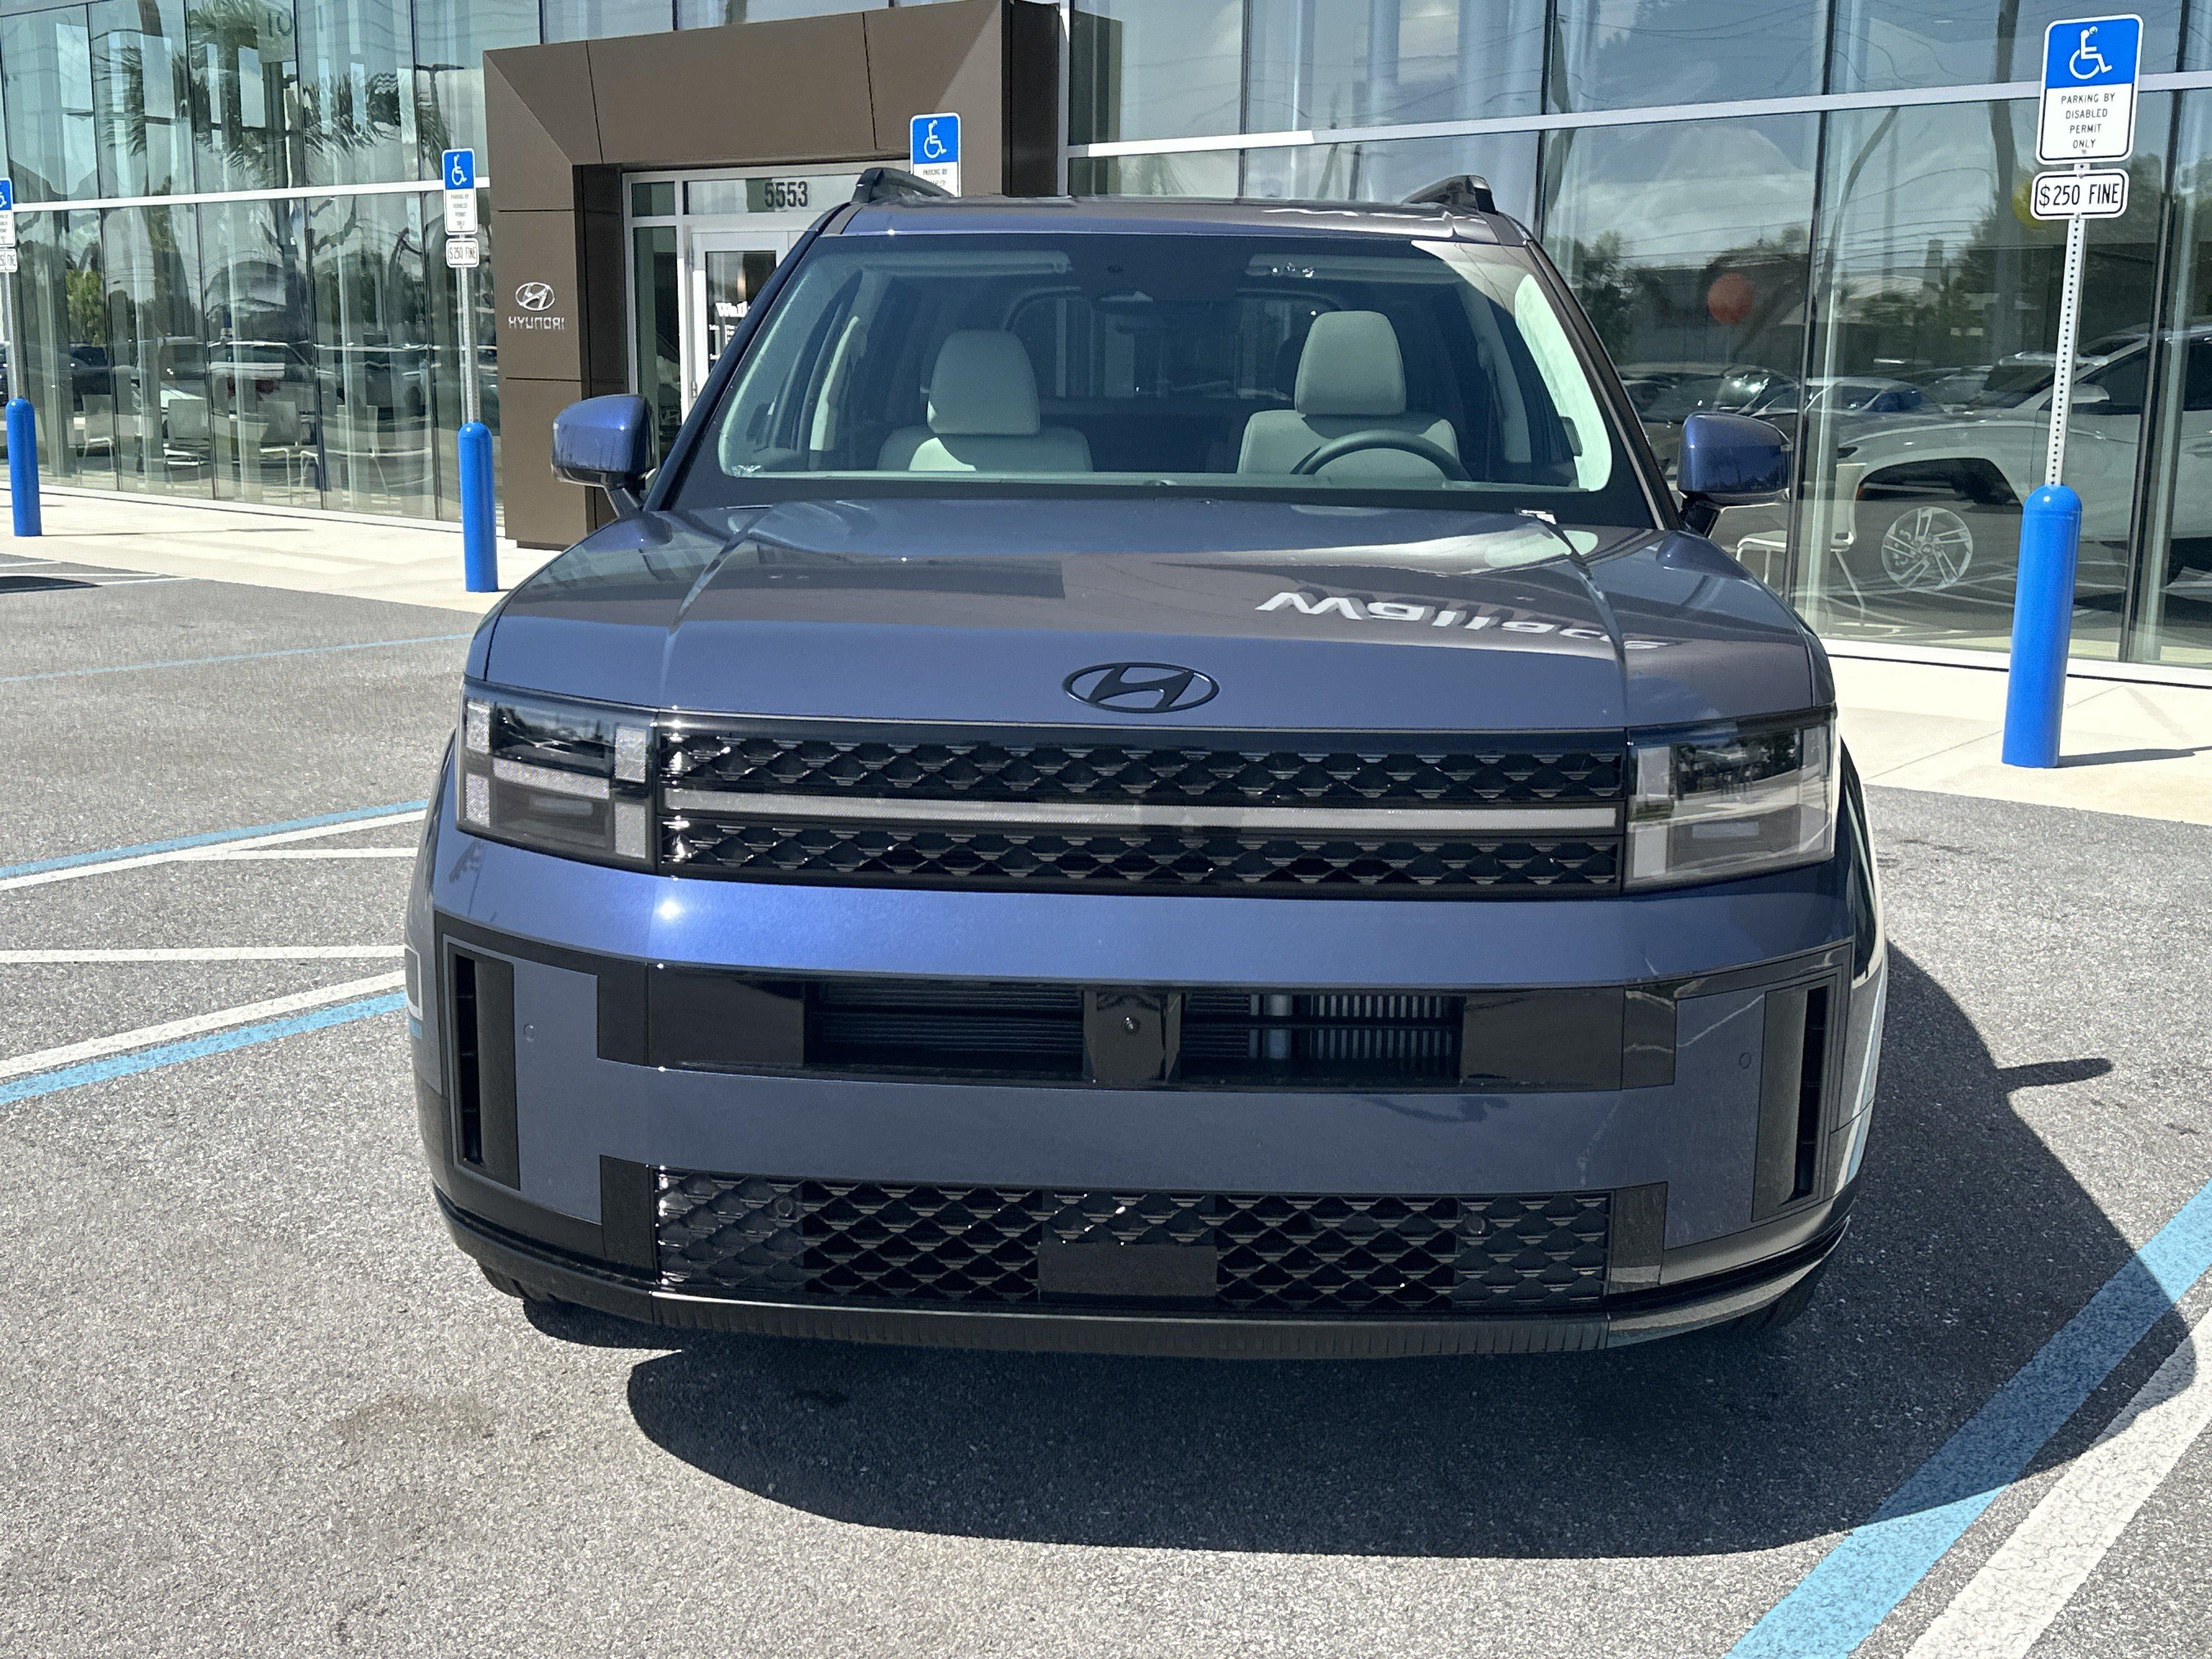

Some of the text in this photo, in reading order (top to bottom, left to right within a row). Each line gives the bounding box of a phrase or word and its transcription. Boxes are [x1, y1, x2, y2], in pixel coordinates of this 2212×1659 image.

[2061, 93, 2115, 104] PARKING BY
[2066, 109, 2108, 119] DISABLED
[2069, 123, 2102, 134] PERMIT
[2073, 139, 2096, 149] ONLY
[764, 181, 808, 207] 5553
[2039, 183, 2120, 208] $250 FINE
[449, 247, 476, 259] $250 FINE
[715, 301, 751, 317] Wall
[508, 316, 565, 330] HYUNDAI
